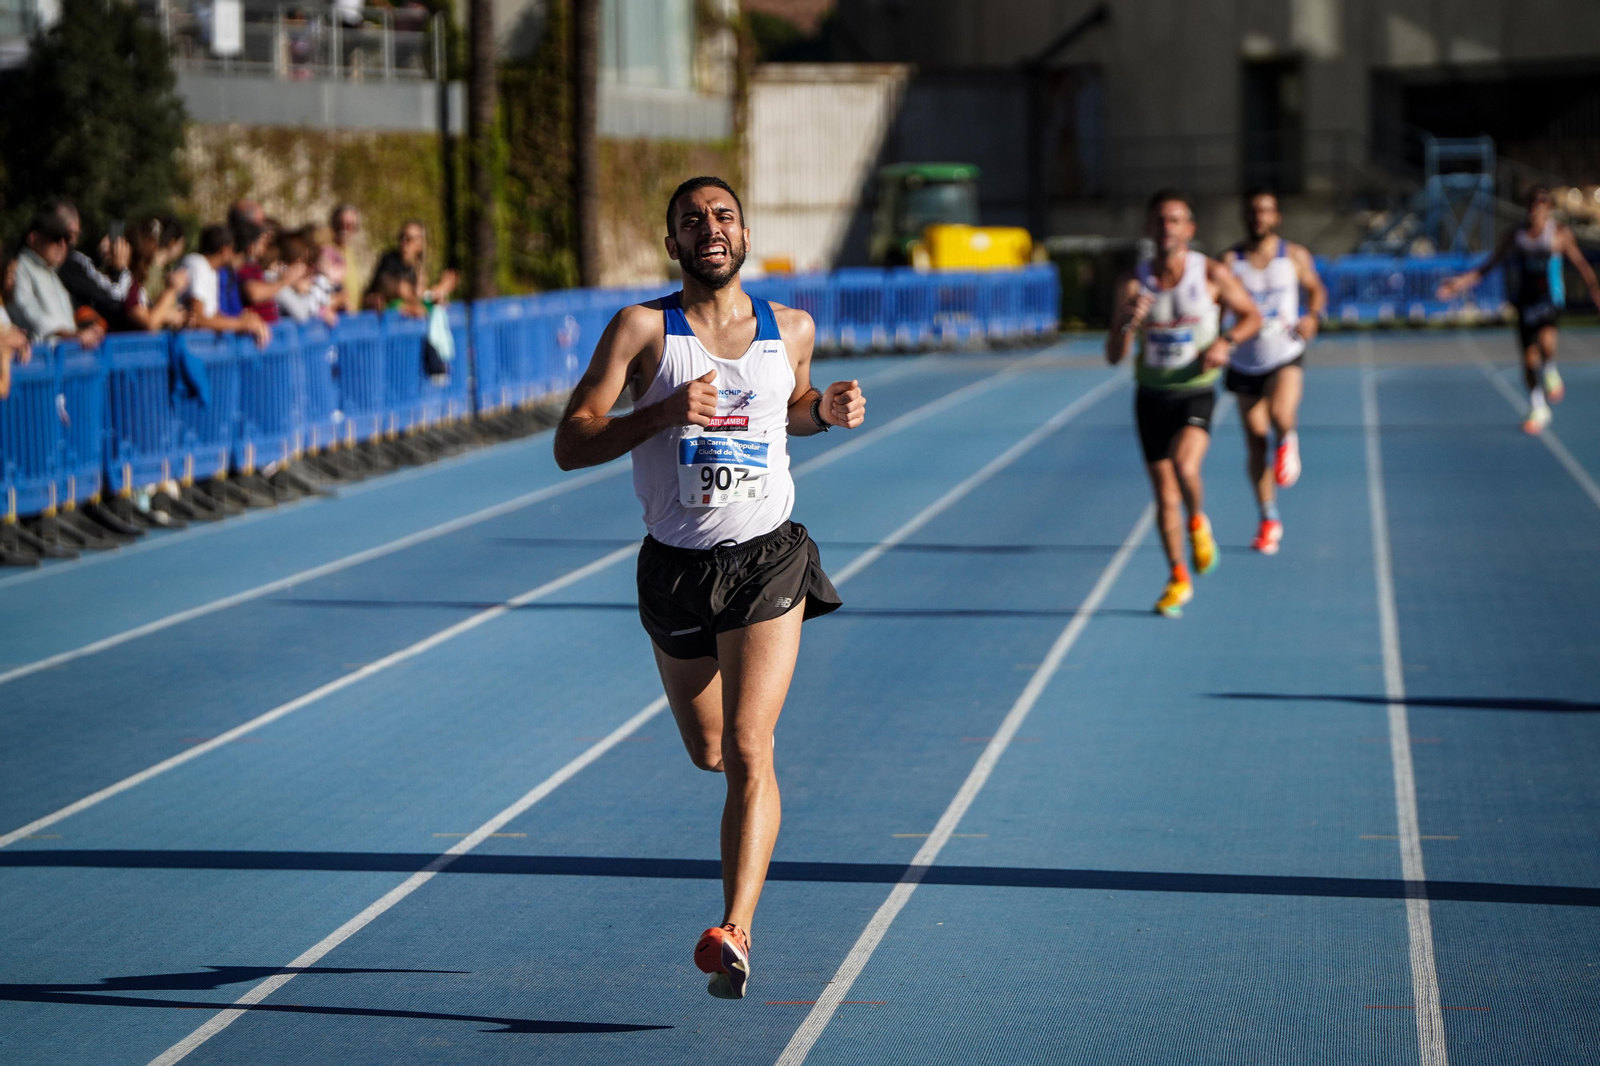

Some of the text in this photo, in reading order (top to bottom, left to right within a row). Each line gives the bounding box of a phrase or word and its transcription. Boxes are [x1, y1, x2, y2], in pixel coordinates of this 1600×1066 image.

[690, 439, 706, 447] XLIII
[734, 441, 761, 451] Popular
[700, 466, 750, 492] 907
